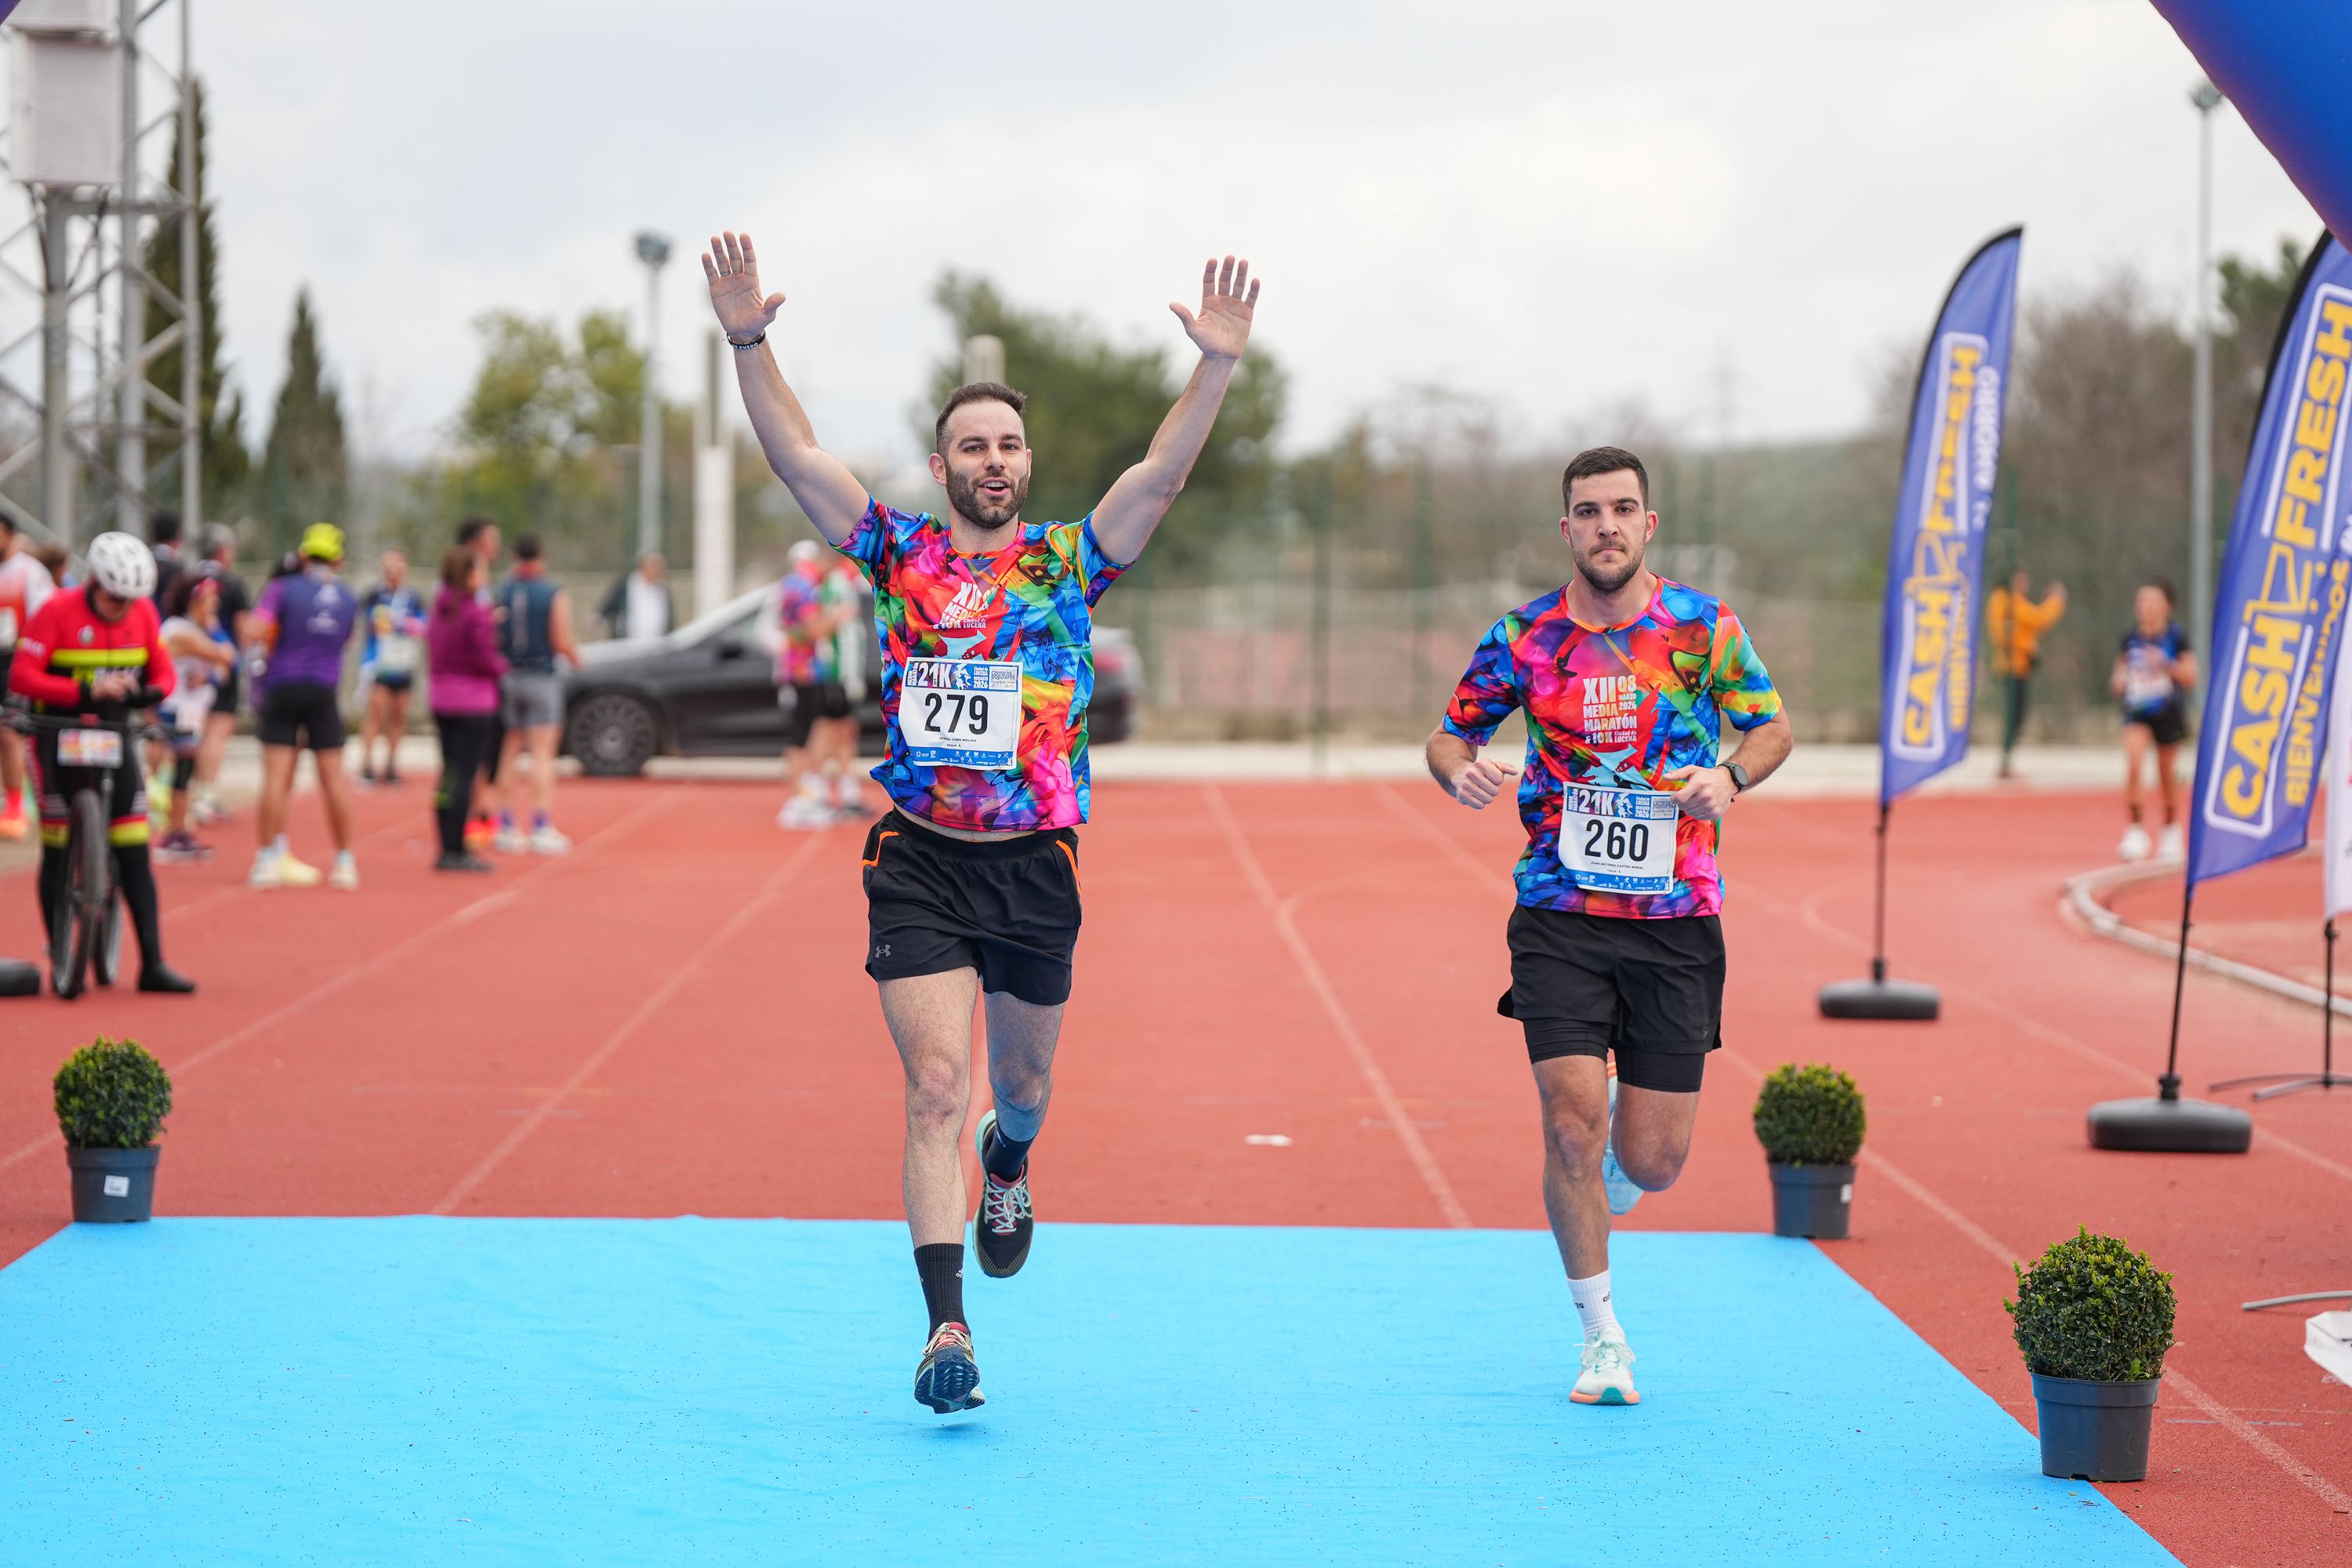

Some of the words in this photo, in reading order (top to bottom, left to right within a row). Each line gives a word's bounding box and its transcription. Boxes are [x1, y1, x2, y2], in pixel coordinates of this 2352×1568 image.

[1926, 345, 1981, 534] FRESH
[2222, 615, 2304, 818] CASH
[2274, 299, 2352, 548] FRESH
[917, 662, 953, 688] 21K
[1903, 587, 1953, 746] CASH
[973, 681, 989, 689] 2026
[1583, 677, 1616, 704] XII
[1617, 675, 1637, 692] 08
[925, 693, 988, 735] 279
[1583, 702, 1619, 719] MEDIA
[1619, 701, 1637, 710] 2026
[1584, 713, 1638, 731] MARATÓN
[1585, 735, 1592, 744] &
[1592, 731, 1613, 743] 10K
[1578, 789, 1615, 816] 21K
[1635, 809, 1650, 818] 2026
[1584, 819, 1649, 862] 260
